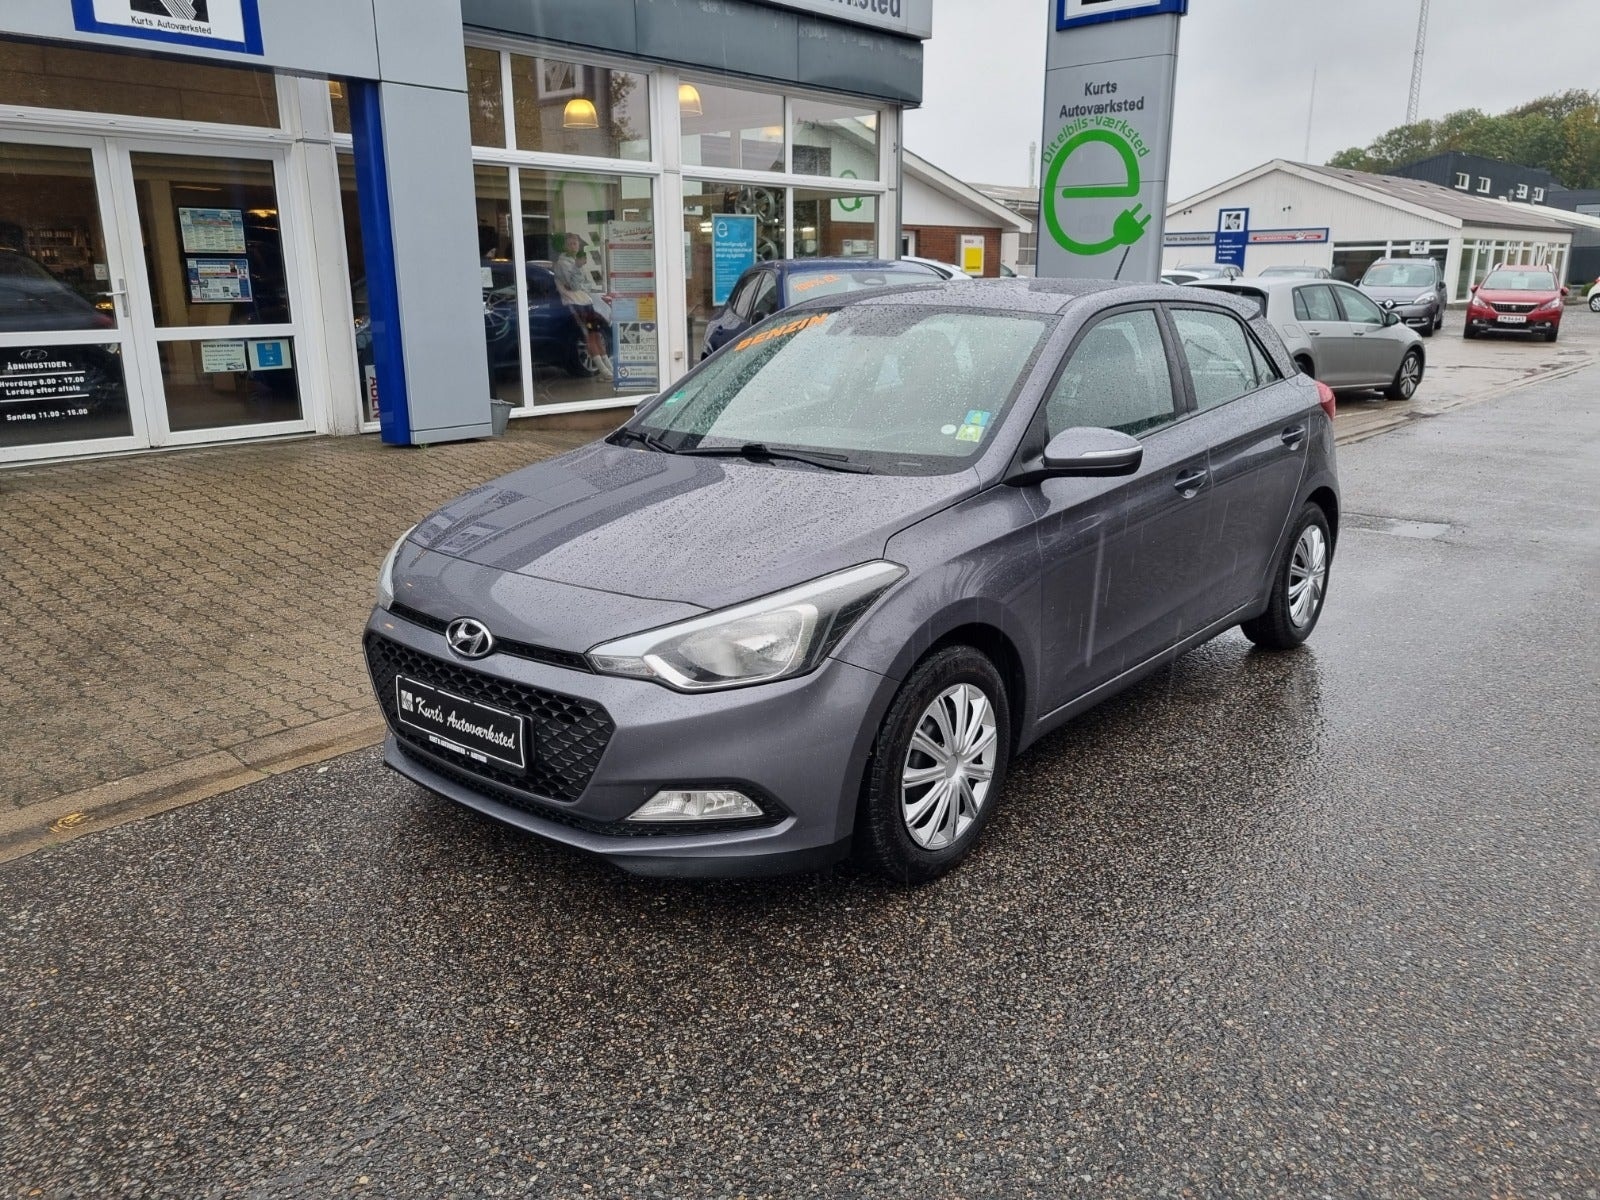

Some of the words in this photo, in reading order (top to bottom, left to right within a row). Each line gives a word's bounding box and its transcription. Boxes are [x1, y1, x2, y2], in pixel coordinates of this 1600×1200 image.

[130, 15, 153, 26] Kurts
[157, 20, 212, 34] Autoværksted
[1084, 80, 1118, 96] Kurts
[1059, 96, 1145, 119] Autoværksted
[1043, 141, 1060, 164] Dit
[1056, 115, 1150, 158] elbils-værksted
[734, 312, 829, 352] BENZIN
[7, 361, 67, 371] ÅBNINGSTIDER
[0, 379, 38, 388] Hverdage
[64, 376, 84, 384] 17.00
[6, 388, 35, 396] Lørdag
[6, 413, 36, 421] Søndag
[416, 697, 443, 723] Kurt's
[447, 711, 515, 749] Autoværksted
